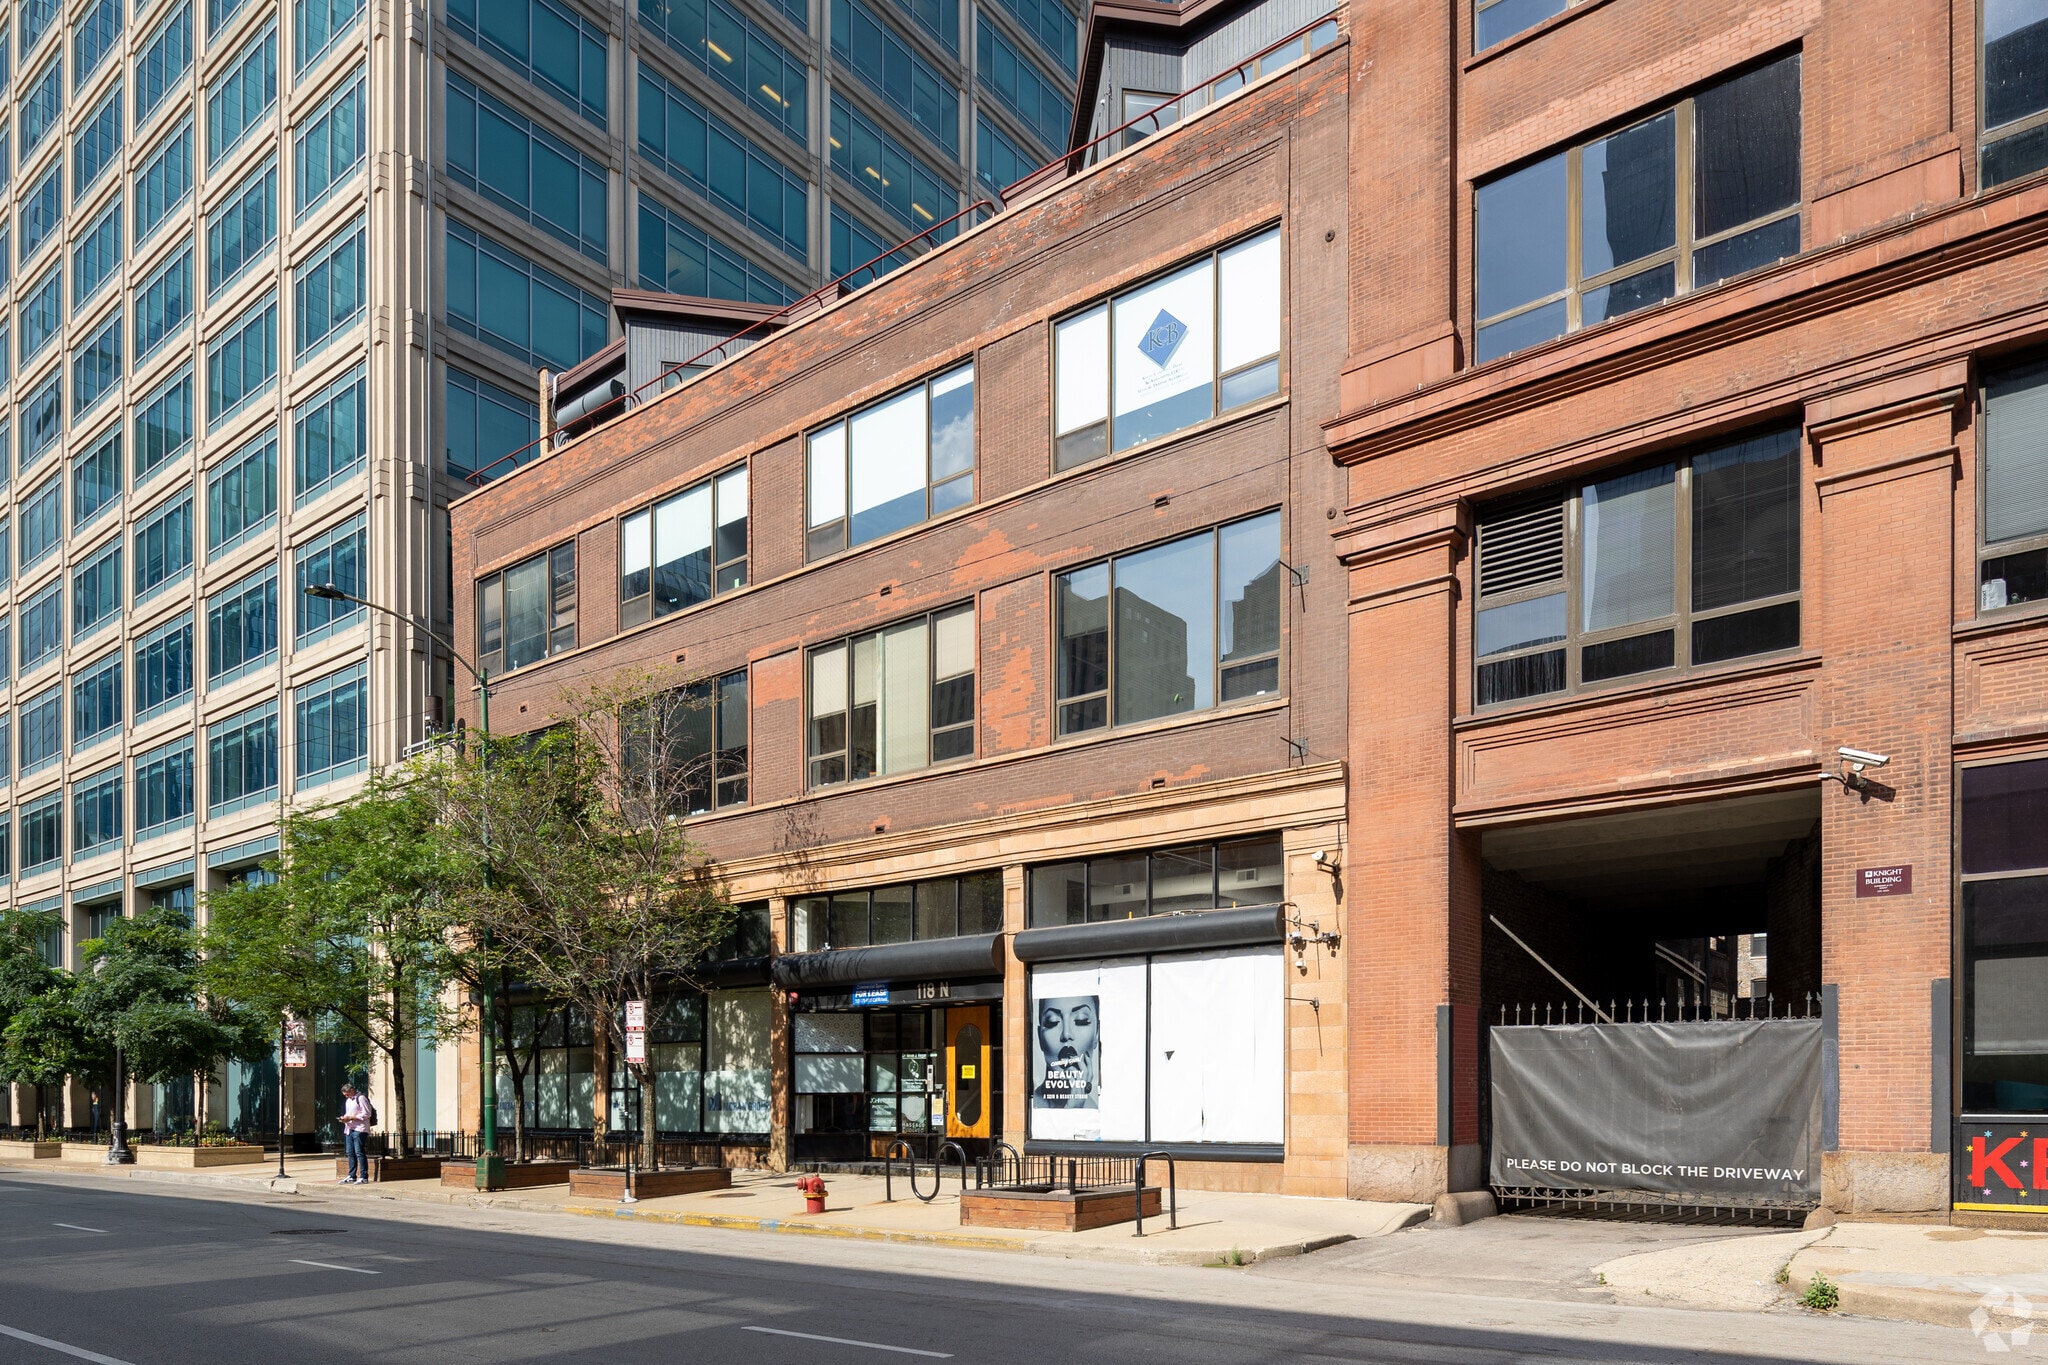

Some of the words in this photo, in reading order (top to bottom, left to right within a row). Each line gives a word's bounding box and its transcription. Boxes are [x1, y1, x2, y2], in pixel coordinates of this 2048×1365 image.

[1148, 322, 1179, 352] KCB
[1873, 868, 1903, 876] KNIGHT
[1865, 876, 1902, 884] BUILDING
[867, 989, 887, 997] LEASE
[917, 983, 935, 999] 118
[940, 981, 949, 997] N
[1047, 1070, 1084, 1079] BEAUTY
[1045, 1080, 1087, 1089] EVOLVED
[1506, 1158, 1556, 1171] PLEASE
[1560, 1161, 1582, 1172] DO
[1586, 1162, 1617, 1173] NOT
[1621, 1163, 1673, 1176] BLOCK
[1677, 1165, 1709, 1178] THE
[1713, 1167, 1805, 1181] DRIVEWAY
